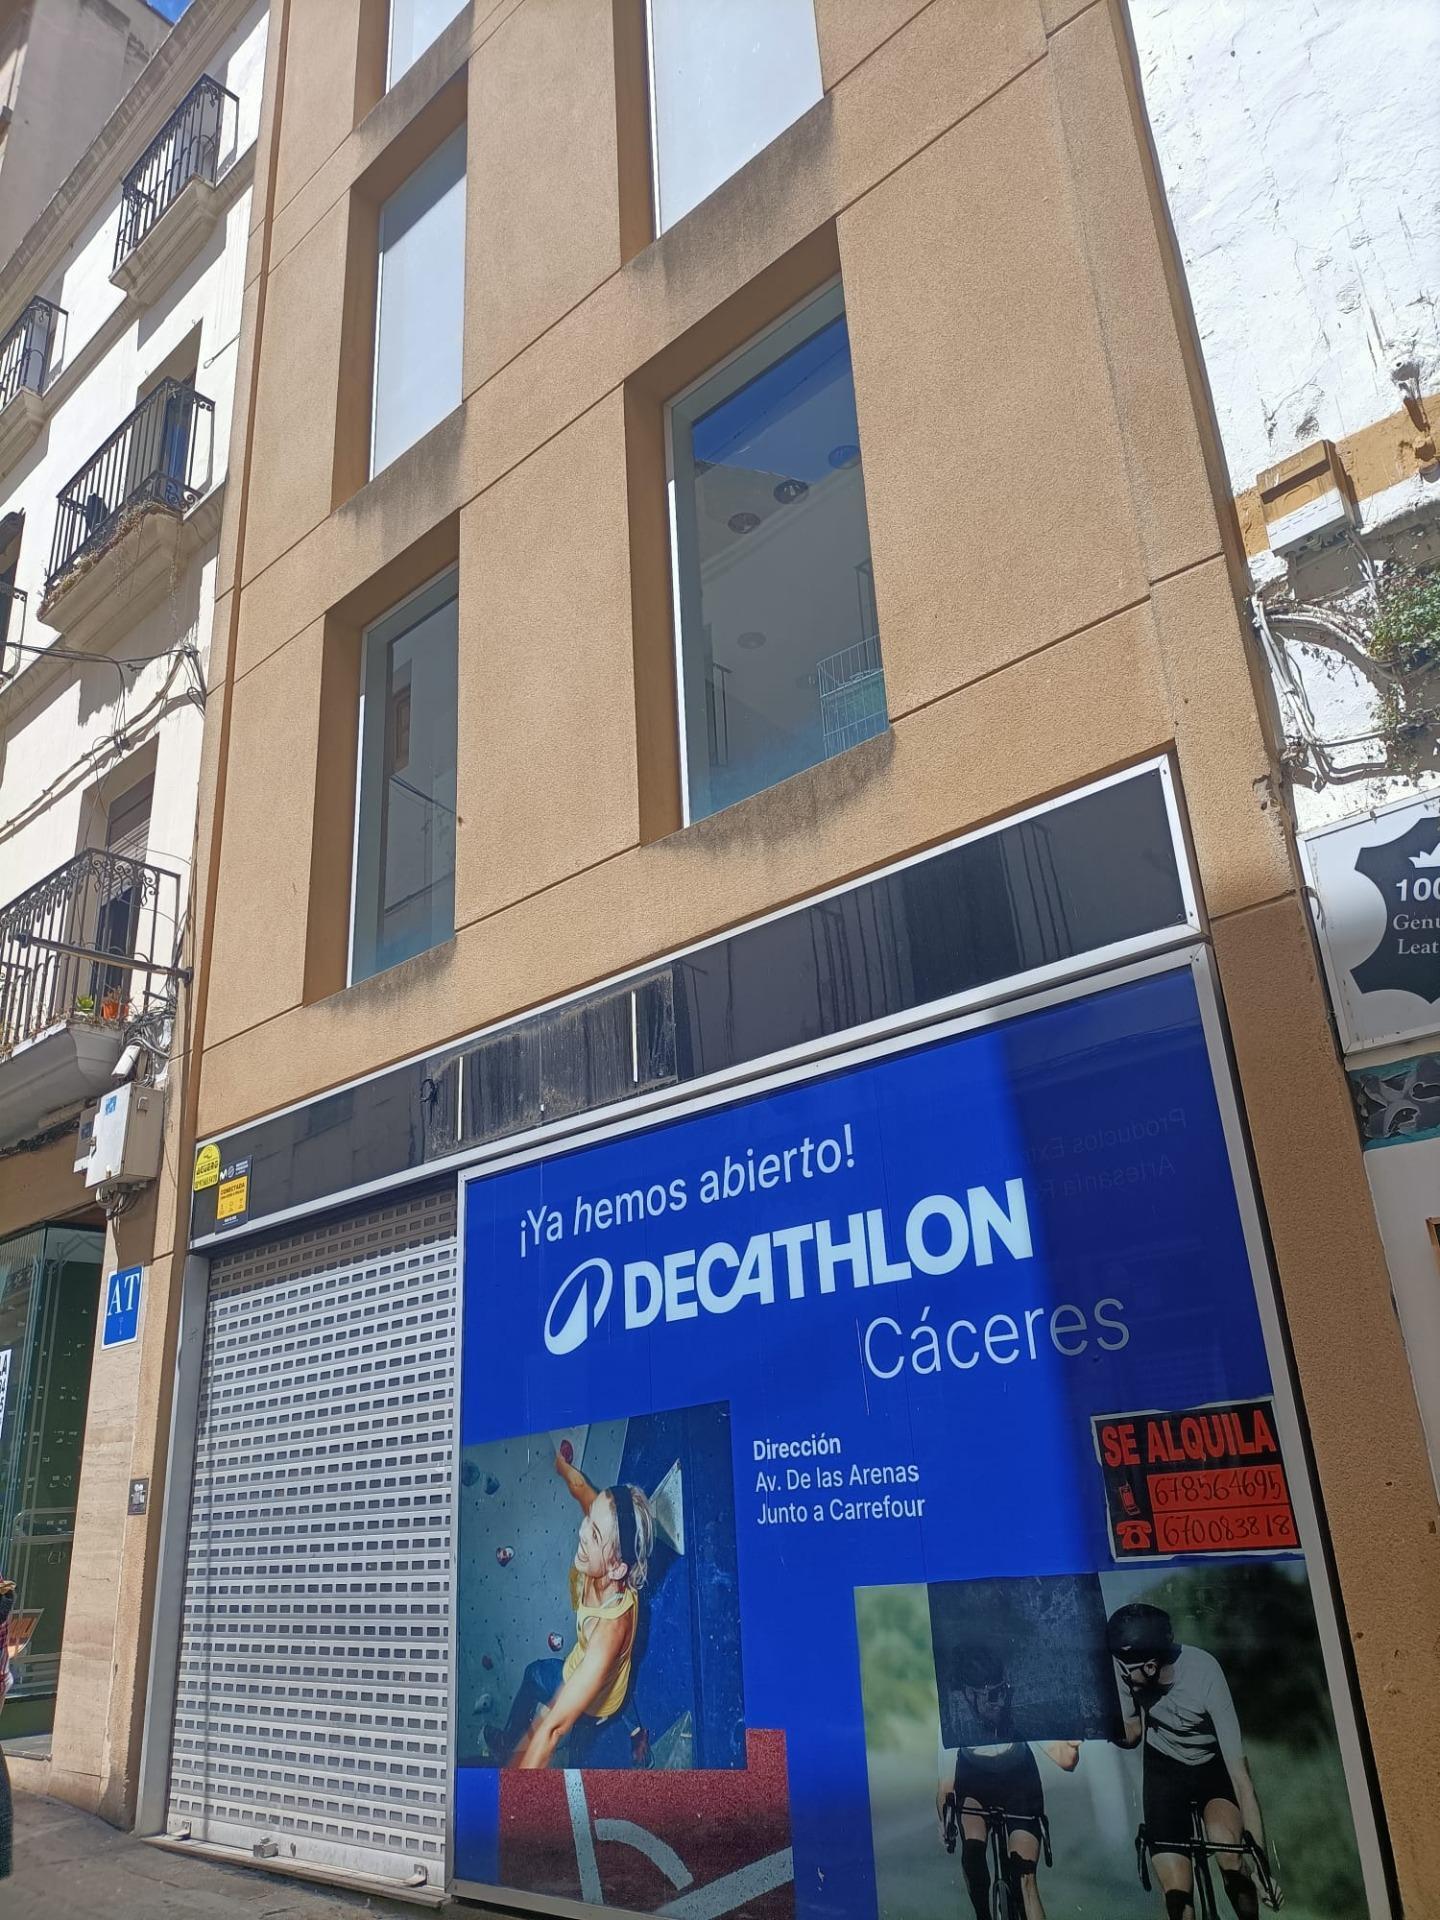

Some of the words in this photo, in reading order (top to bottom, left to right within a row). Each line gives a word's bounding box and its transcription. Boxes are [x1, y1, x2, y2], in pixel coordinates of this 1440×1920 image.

[520, 1205, 563, 1258] ¡Ya
[573, 1179, 687, 1236] hemos
[699, 1123, 855, 1204] abierto!
[624, 1177, 1034, 1330] DECATHLON
[107, 1273, 140, 1317] AT
[864, 1297, 1130, 1380] Cáceres
[753, 1432, 841, 1461] Dirección
[1102, 1424, 1141, 1467] SE
[1147, 1409, 1277, 1464] ALQUILA
[755, 1471, 781, 1493] Av.
[787, 1469, 811, 1490] De
[816, 1466, 843, 1488] las
[849, 1464, 920, 1486] Arenas
[1155, 1469, 1281, 1506] 678564695
[757, 1503, 808, 1525] Junto
[813, 1504, 824, 1522] a
[829, 1495, 926, 1521] Carrefour
